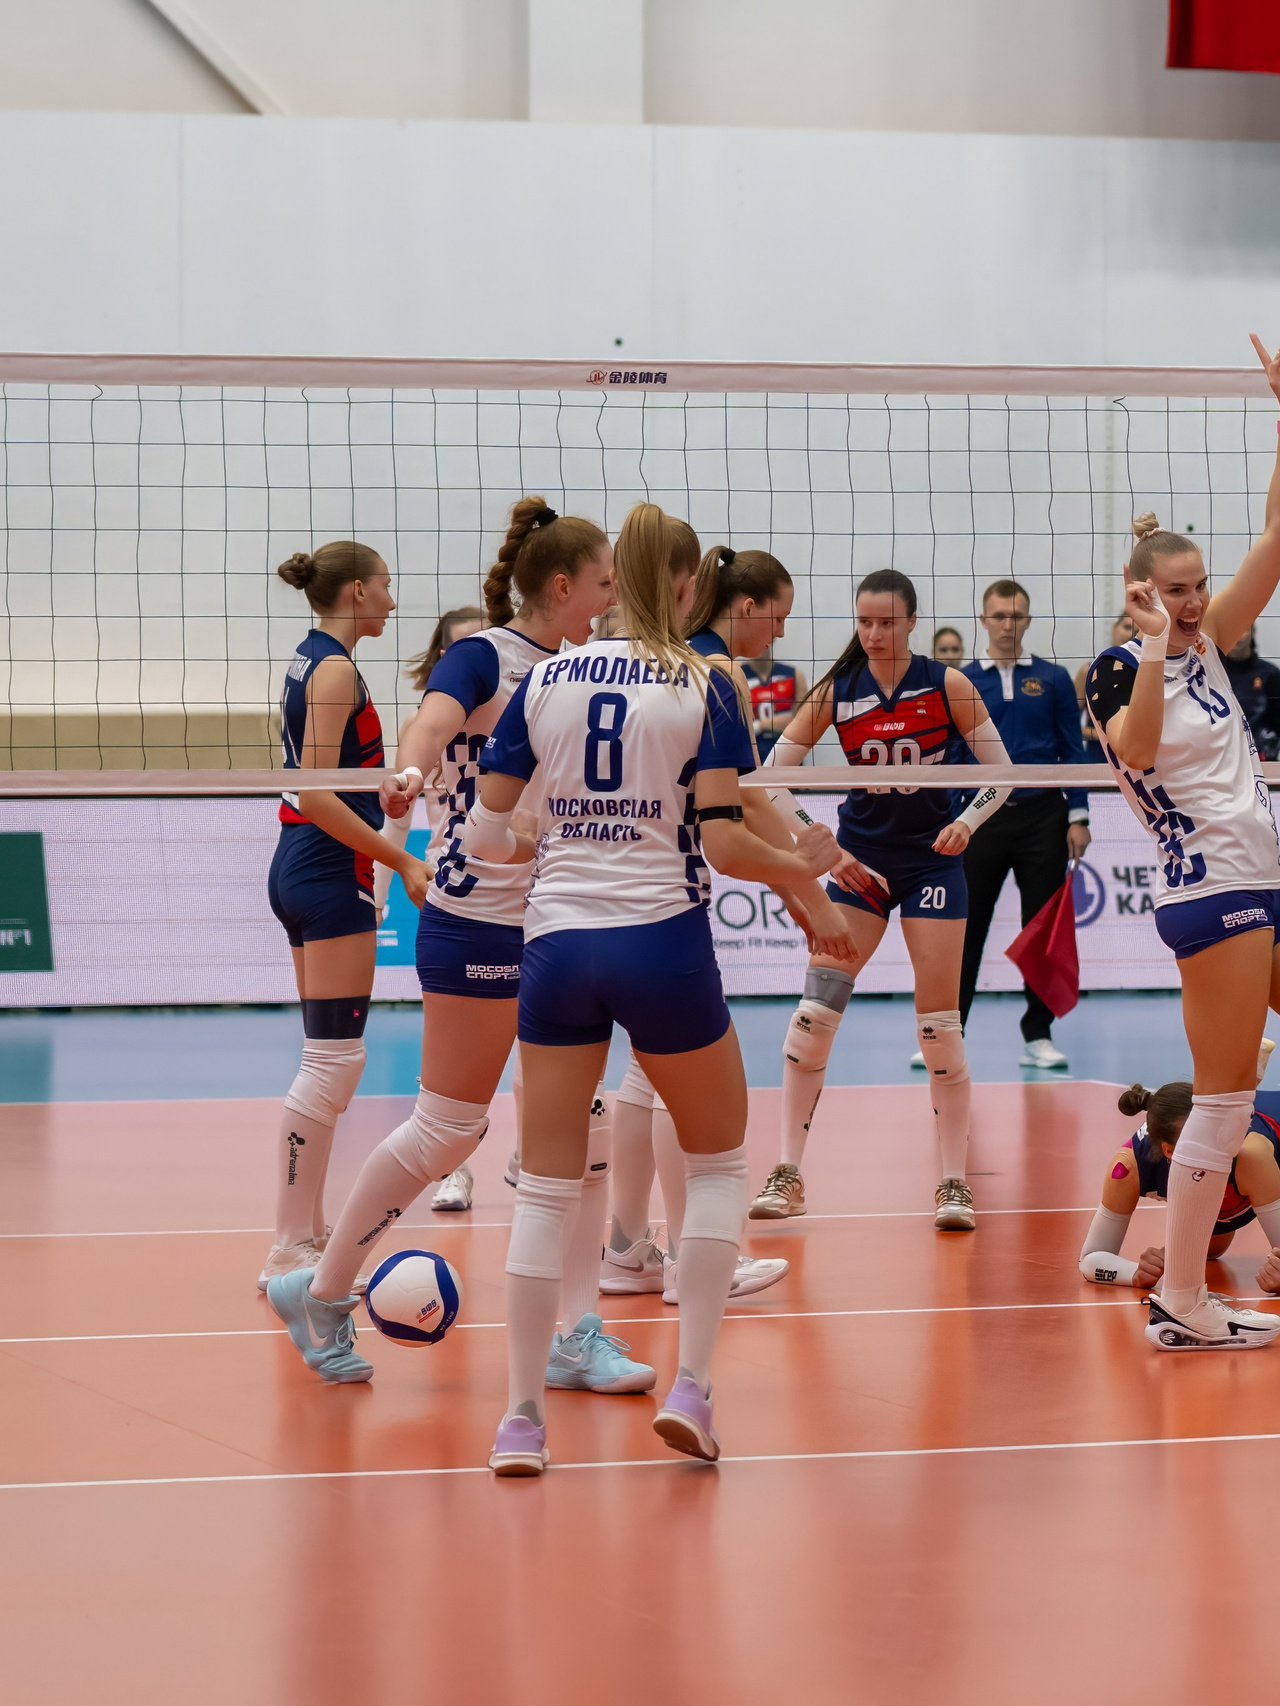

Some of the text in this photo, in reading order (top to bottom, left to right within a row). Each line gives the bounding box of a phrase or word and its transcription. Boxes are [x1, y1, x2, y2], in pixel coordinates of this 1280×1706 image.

[609, 371, 667, 384] 金陵体育
[584, 692, 628, 792] 8
[561, 822, 642, 842] ОБЛАСТЬ
[919, 886, 946, 910] 20
